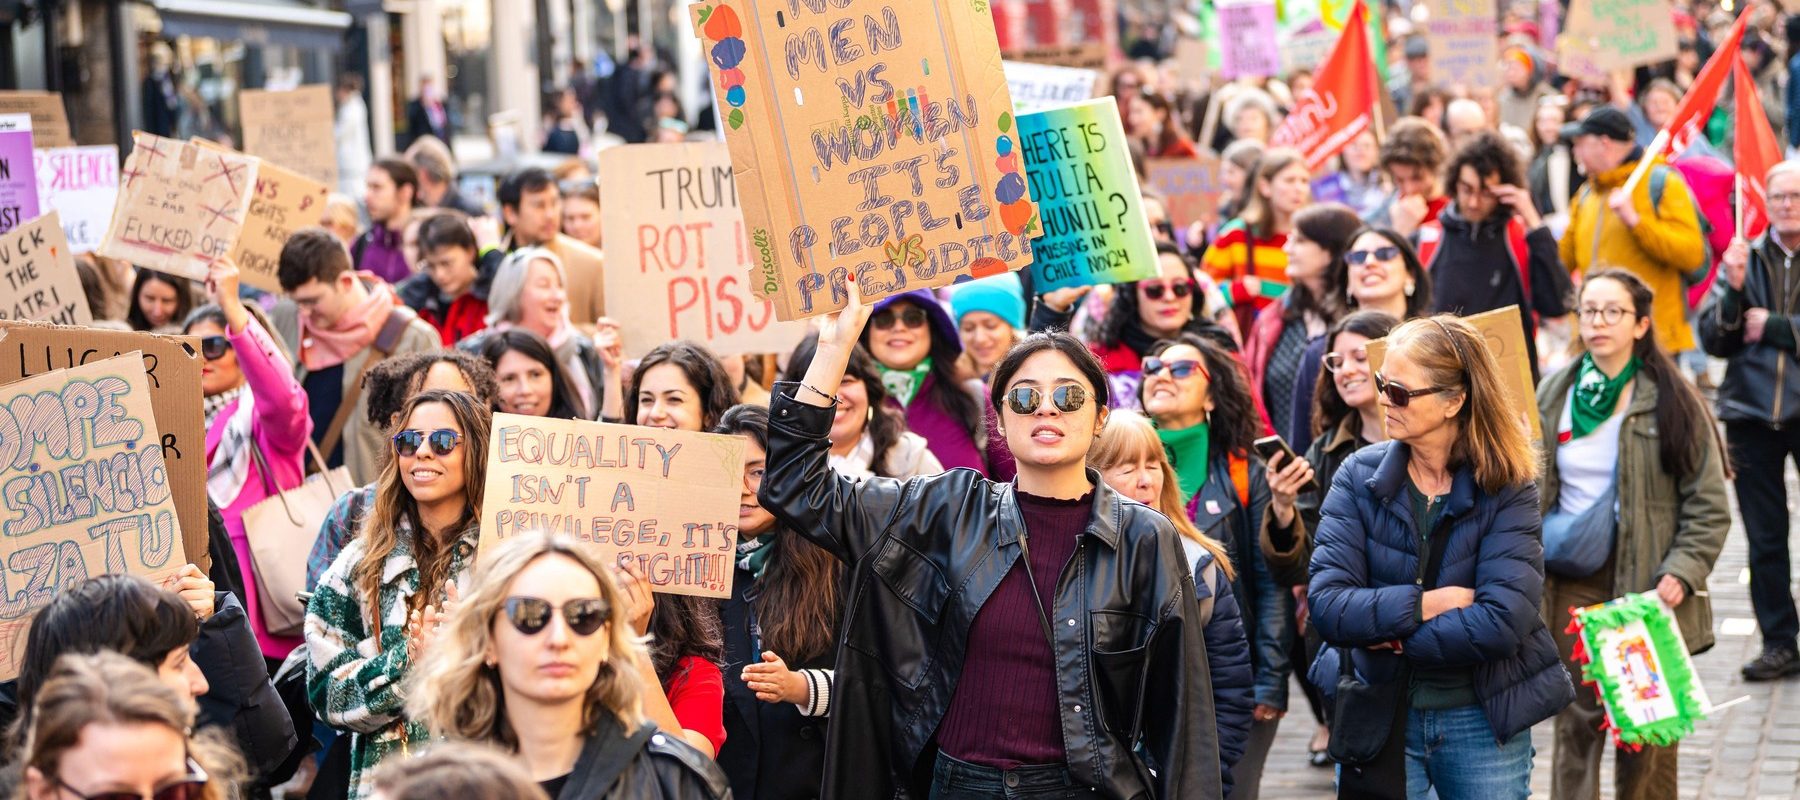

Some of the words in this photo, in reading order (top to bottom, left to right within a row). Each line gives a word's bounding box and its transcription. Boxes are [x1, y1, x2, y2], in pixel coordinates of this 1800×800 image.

[785, 6, 902, 81] MEN
[835, 62, 895, 110] VS
[811, 94, 979, 170] WOMEN
[1078, 122, 1107, 154] IS
[847, 147, 961, 213] IT'S
[1027, 162, 1104, 203] JULIA
[122, 216, 194, 250] FUCKED
[200, 233, 228, 257] OFF
[637, 221, 714, 273] ROT
[789, 184, 991, 269] PEOPLE
[883, 234, 927, 268] VS
[1036, 237, 1090, 264] MISSING
[1091, 233, 1108, 250] IN
[5, 260, 40, 291] THE
[753, 228, 778, 295] Driscoll's
[797, 230, 1034, 314] PREJUDICE
[1042, 260, 1082, 284] CHILE
[1086, 248, 1131, 275] NOV24
[498, 425, 683, 478] EQUALITY
[3, 444, 172, 538] SILENCIO
[509, 474, 591, 509] ISN'T
[610, 481, 635, 512] A
[87, 511, 174, 578] TU
[495, 509, 672, 548] PRIVILEGE,
[681, 521, 738, 552] IT'S
